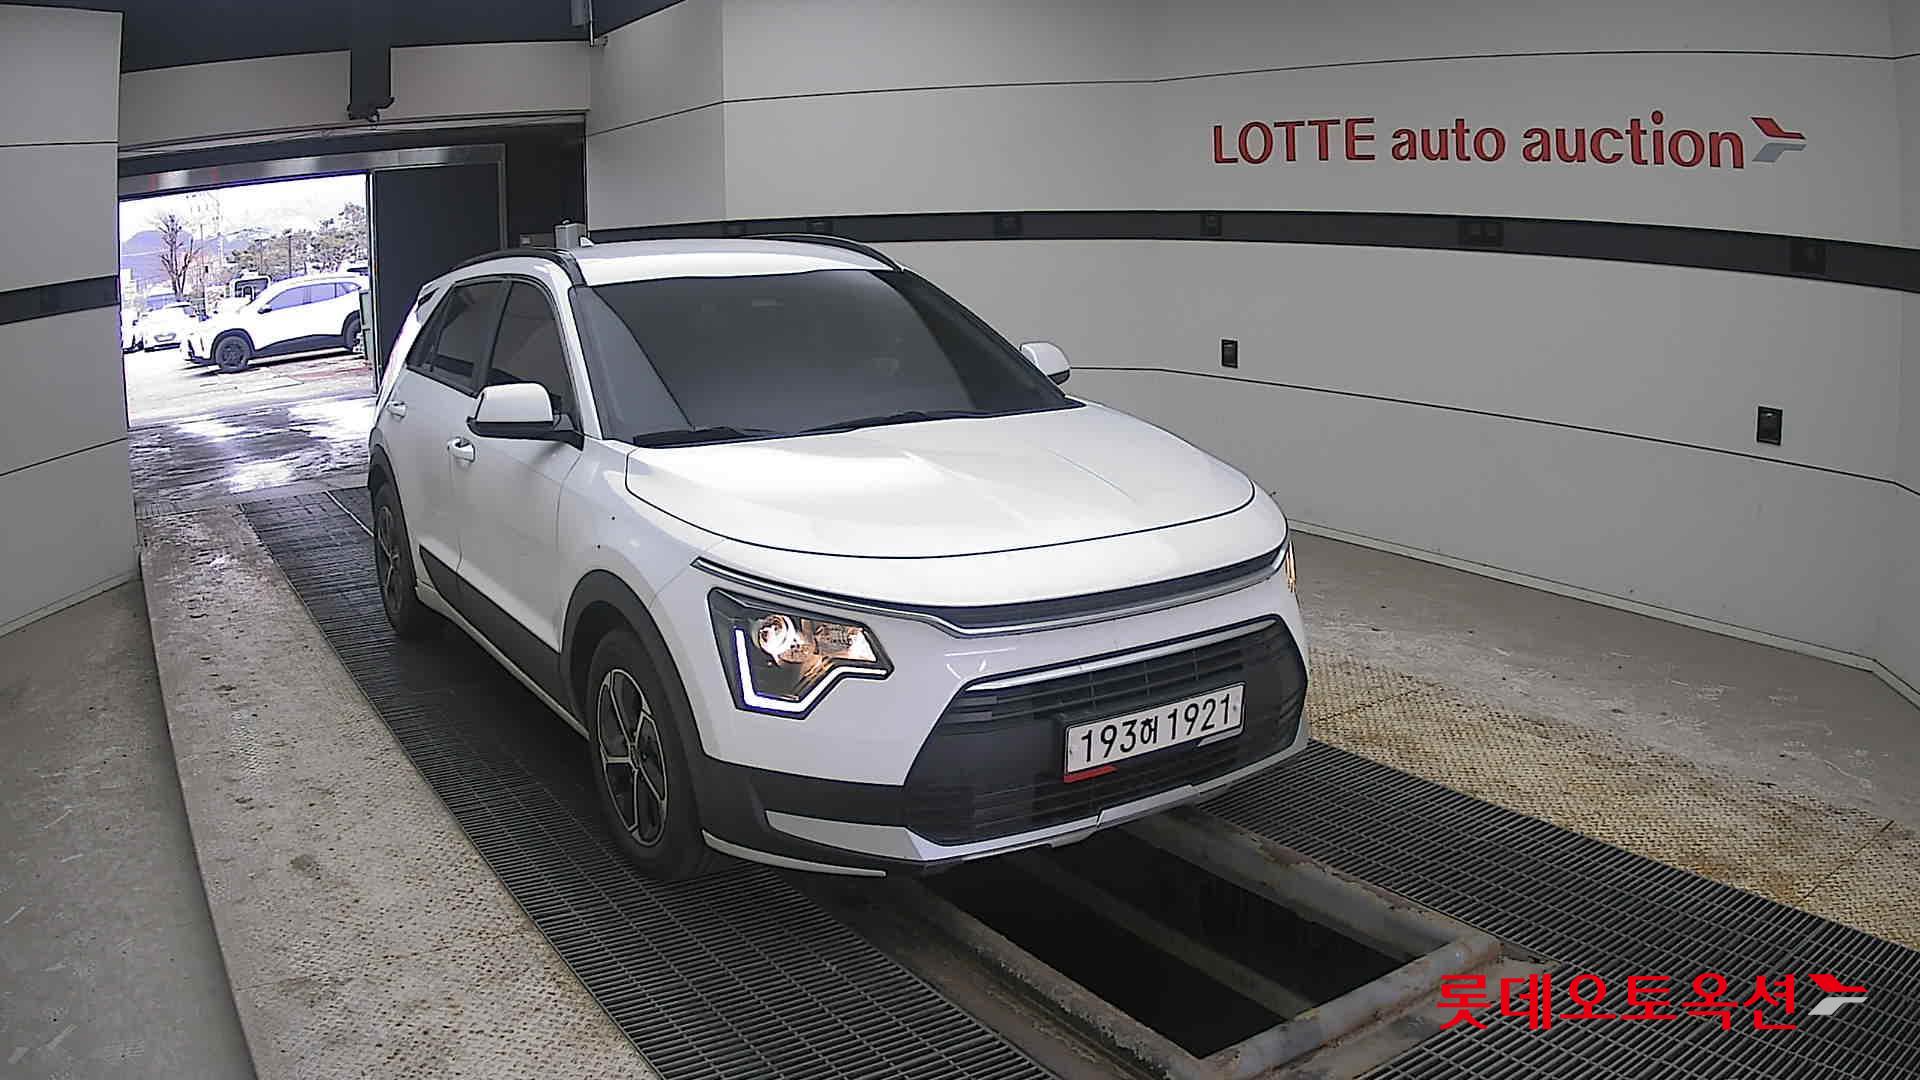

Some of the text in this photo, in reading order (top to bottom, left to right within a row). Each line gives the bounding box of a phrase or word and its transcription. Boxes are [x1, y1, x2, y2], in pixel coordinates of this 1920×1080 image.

[1213, 111, 1745, 169] LOTTE auto auction
[1167, 693, 1230, 740] 1921
